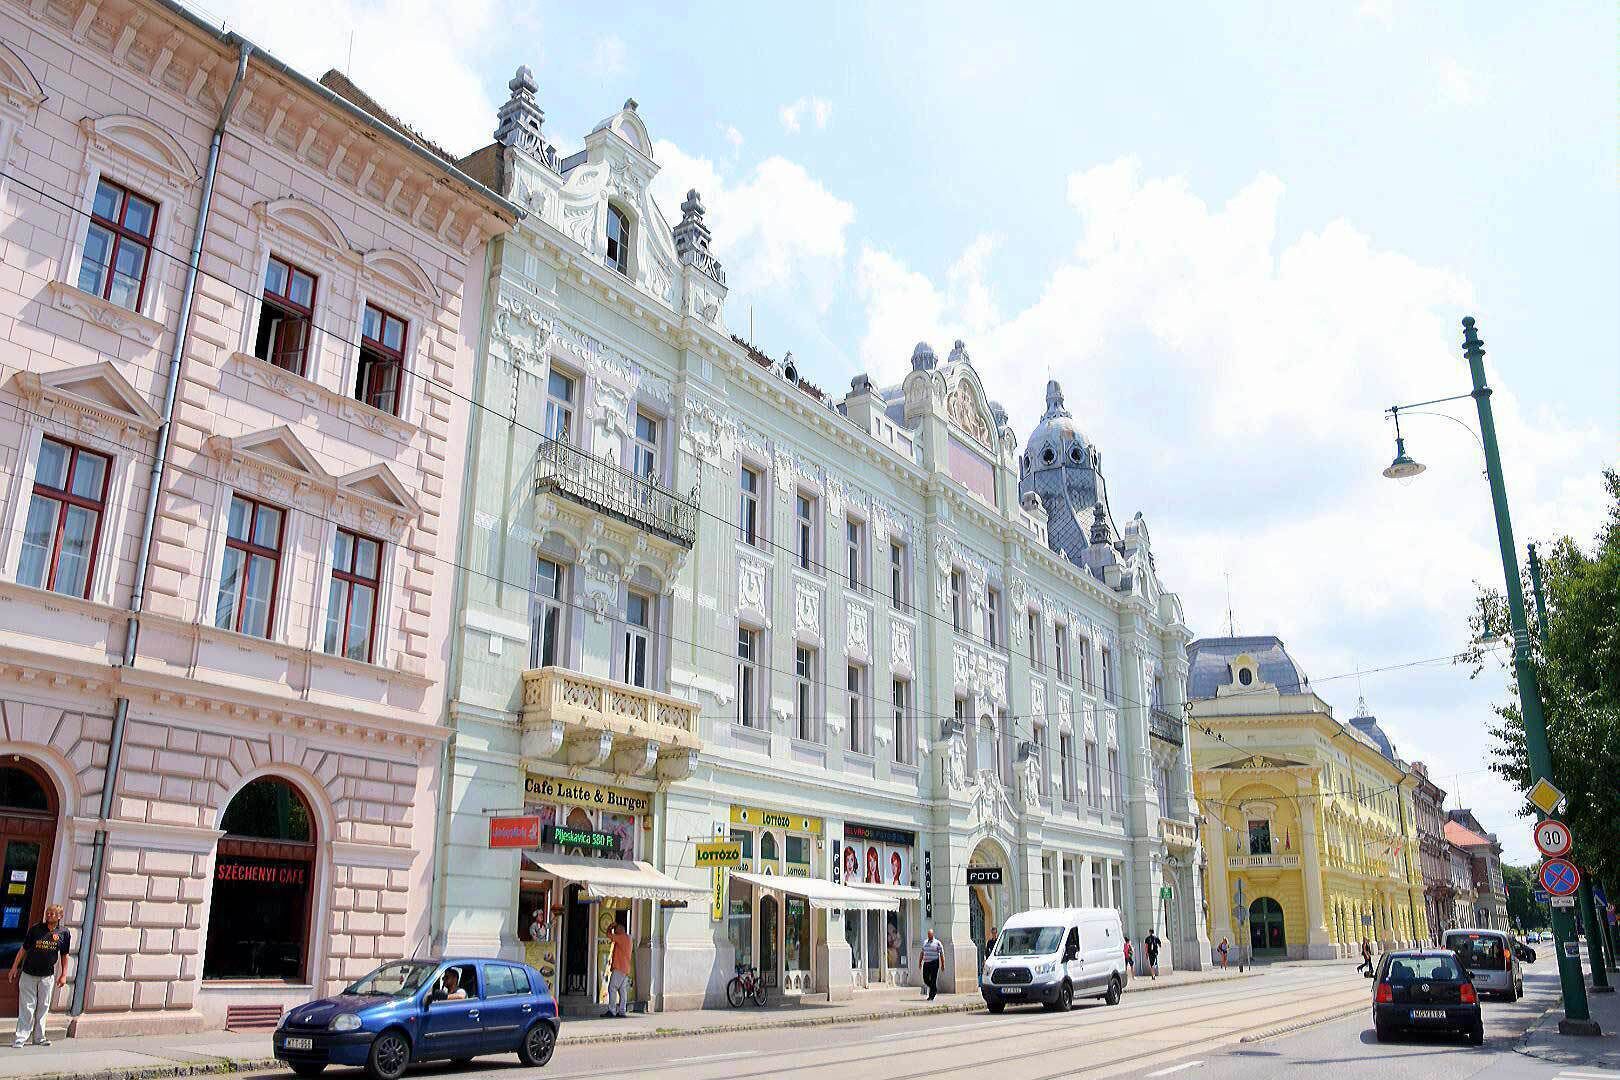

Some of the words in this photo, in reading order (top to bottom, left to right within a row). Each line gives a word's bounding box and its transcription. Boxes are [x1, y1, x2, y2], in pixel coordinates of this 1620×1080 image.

[525, 778, 554, 796] Cafe
[557, 783, 590, 800] Latte
[594, 789, 604, 803] &
[607, 791, 648, 810] Burger
[762, 811, 790, 828] LOTTÓZÓ
[1544, 830, 1561, 846] 30
[697, 848, 739, 861] LOTTÓZÓ
[218, 863, 277, 882] SZÉCHENYI
[970, 872, 1000, 880] FOTO
